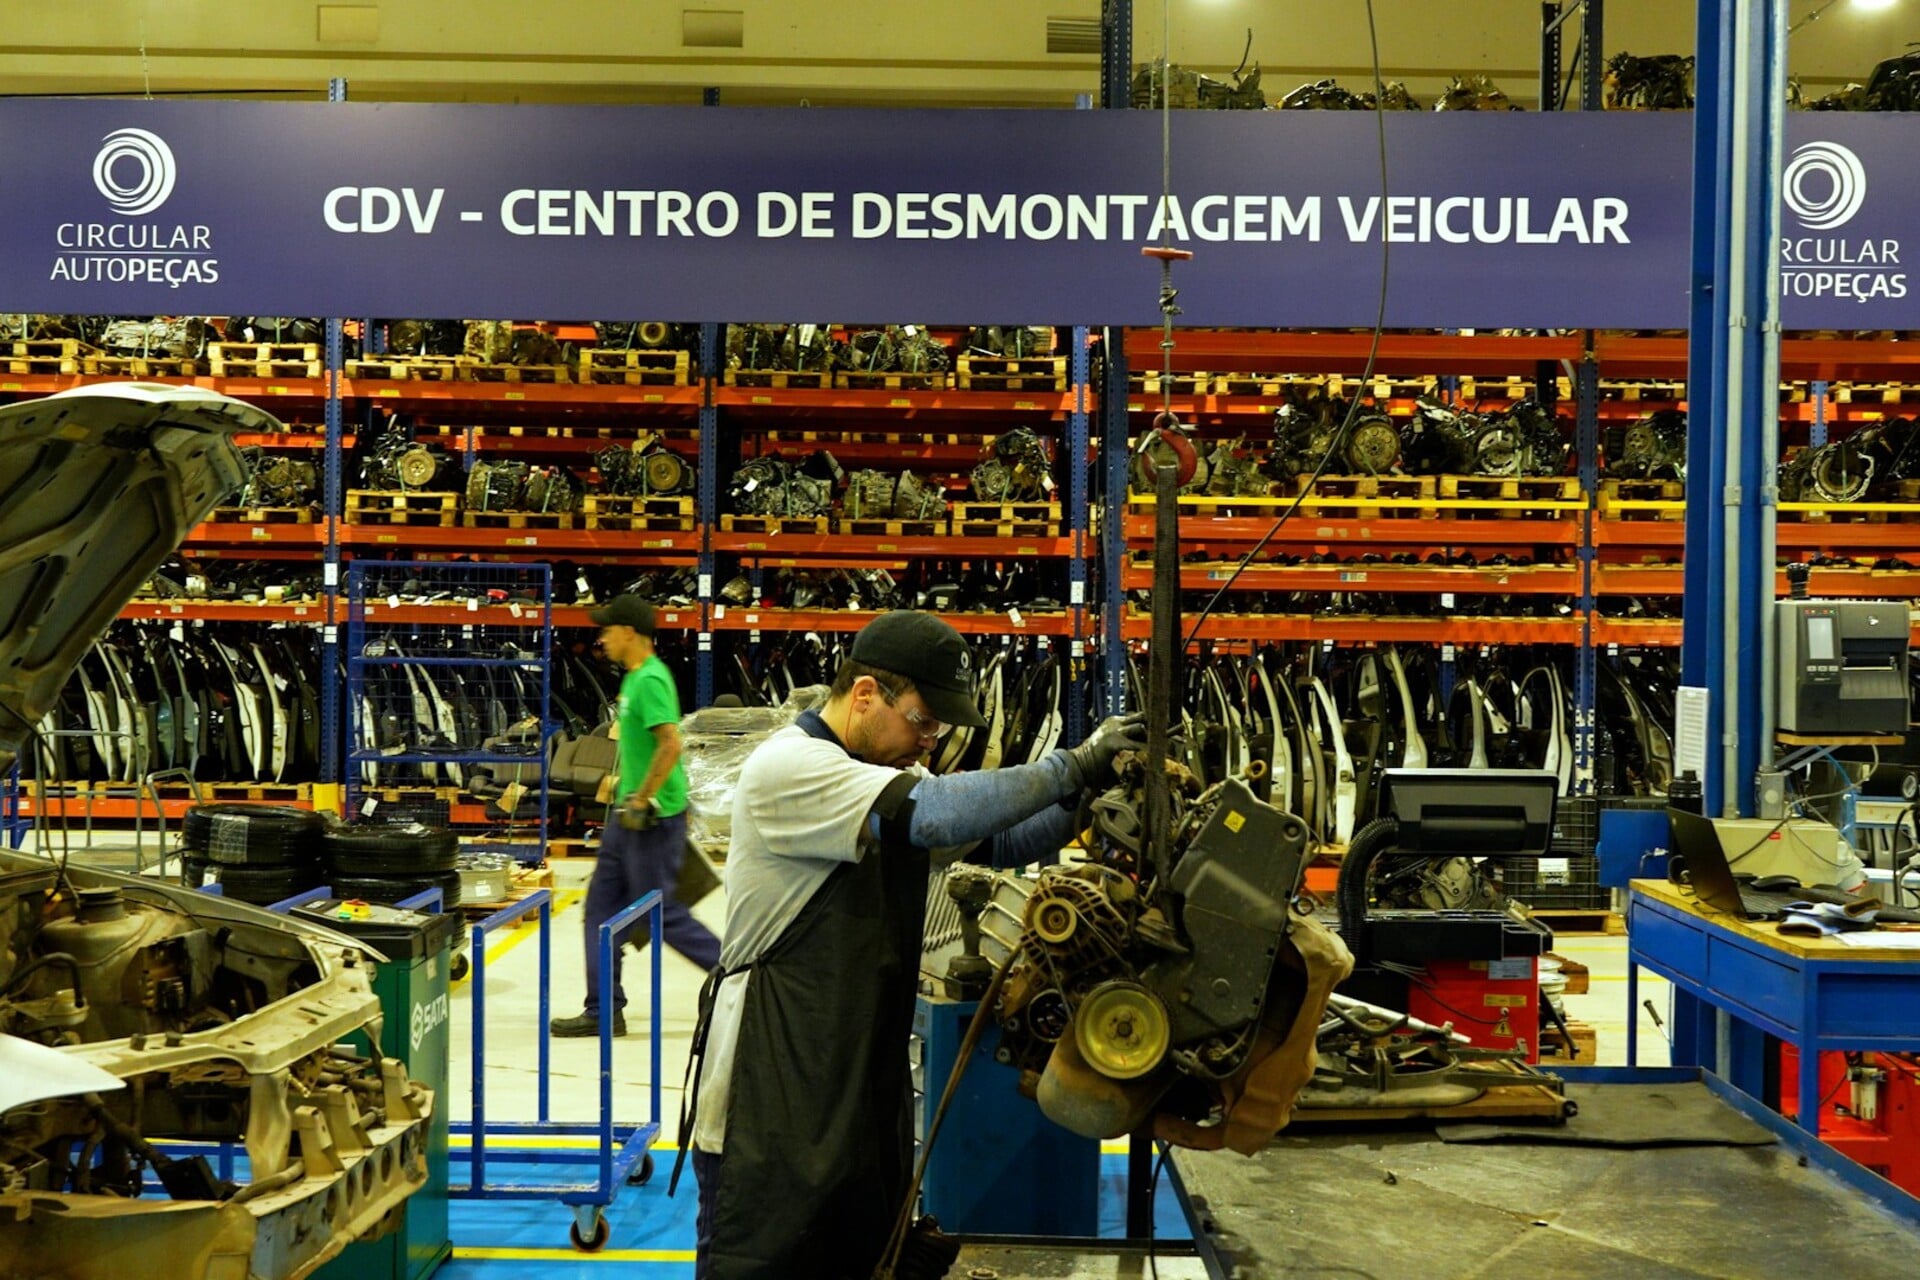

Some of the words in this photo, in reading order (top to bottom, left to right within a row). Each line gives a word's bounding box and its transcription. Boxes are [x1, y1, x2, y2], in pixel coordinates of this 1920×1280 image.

[324, 187, 444, 234] CDV
[460, 211, 483, 222] -
[500, 189, 739, 238] CENTRO
[757, 191, 835, 238] DE
[852, 193, 1321, 243] DESMONTAGEM
[1338, 196, 1631, 244] VEICULAR
[56, 222, 212, 250] CIRCULAR
[1781, 237, 1900, 264] RCULAR
[50, 256, 219, 289] AUTOPEÇAS
[1781, 271, 1908, 304] TOPEÇAS
[423, 992, 448, 1035] SATA
